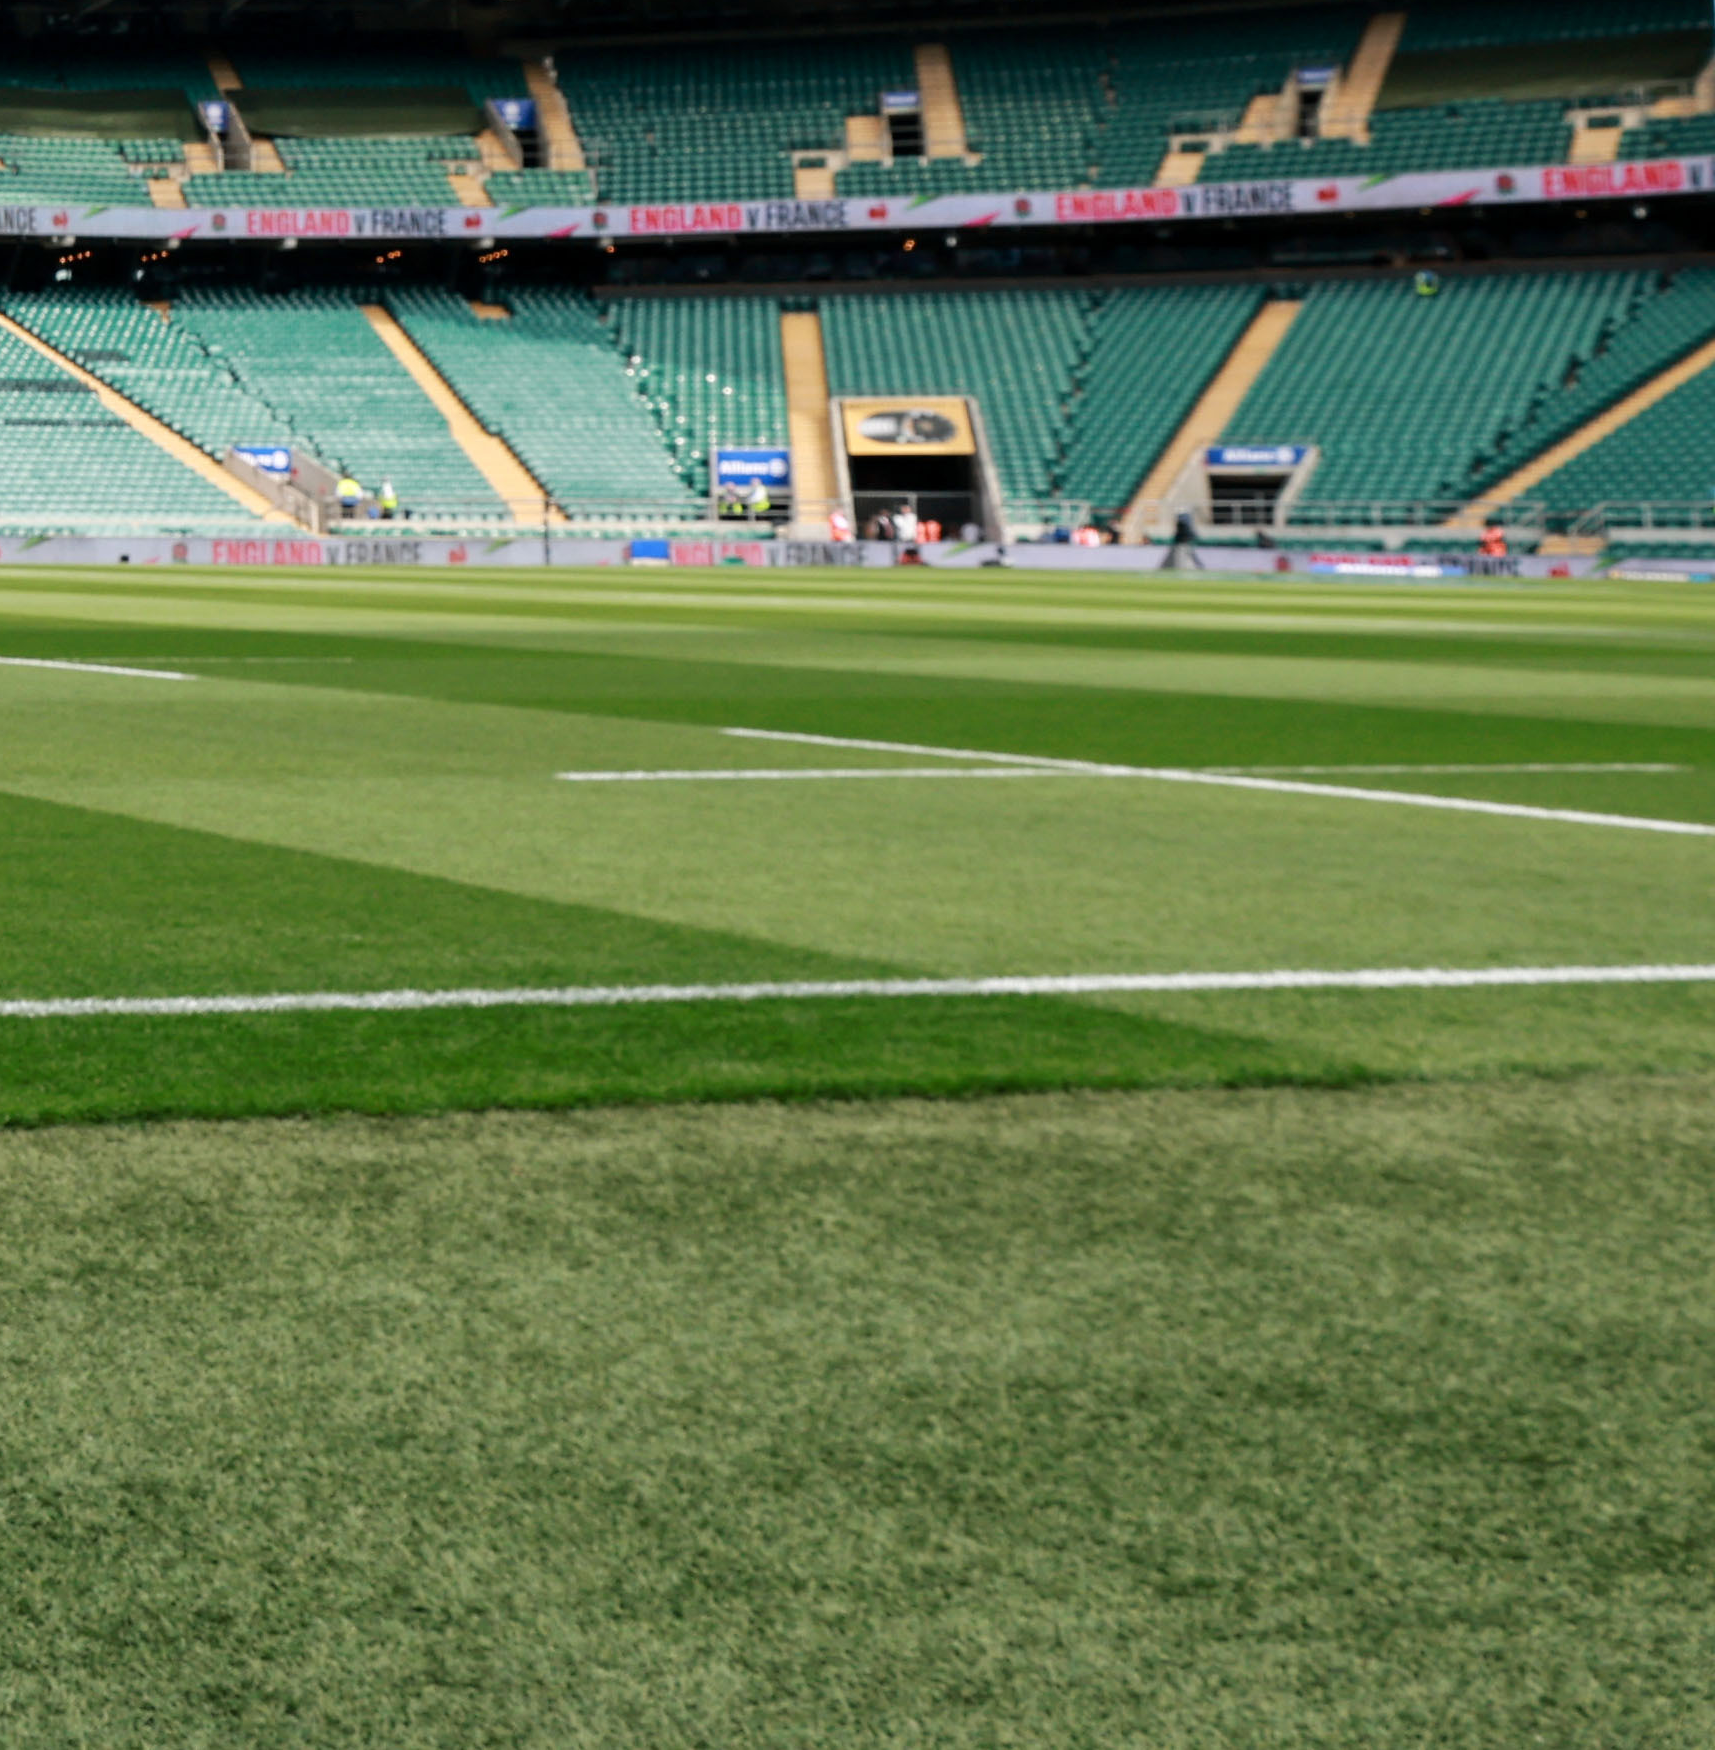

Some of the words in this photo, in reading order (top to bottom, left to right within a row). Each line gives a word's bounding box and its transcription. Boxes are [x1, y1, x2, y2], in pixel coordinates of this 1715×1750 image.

[1543, 161, 1683, 197] ENGLAND
[631, 204, 743, 233] ENGLAND
[765, 200, 847, 230] FRANCE
[1055, 187, 1178, 220] ENGLAND
[1201, 180, 1294, 213] FRANCE
[247, 210, 350, 235] ENGLAND
[370, 210, 447, 236] FRANCE
[720, 461, 769, 475] Allianz
